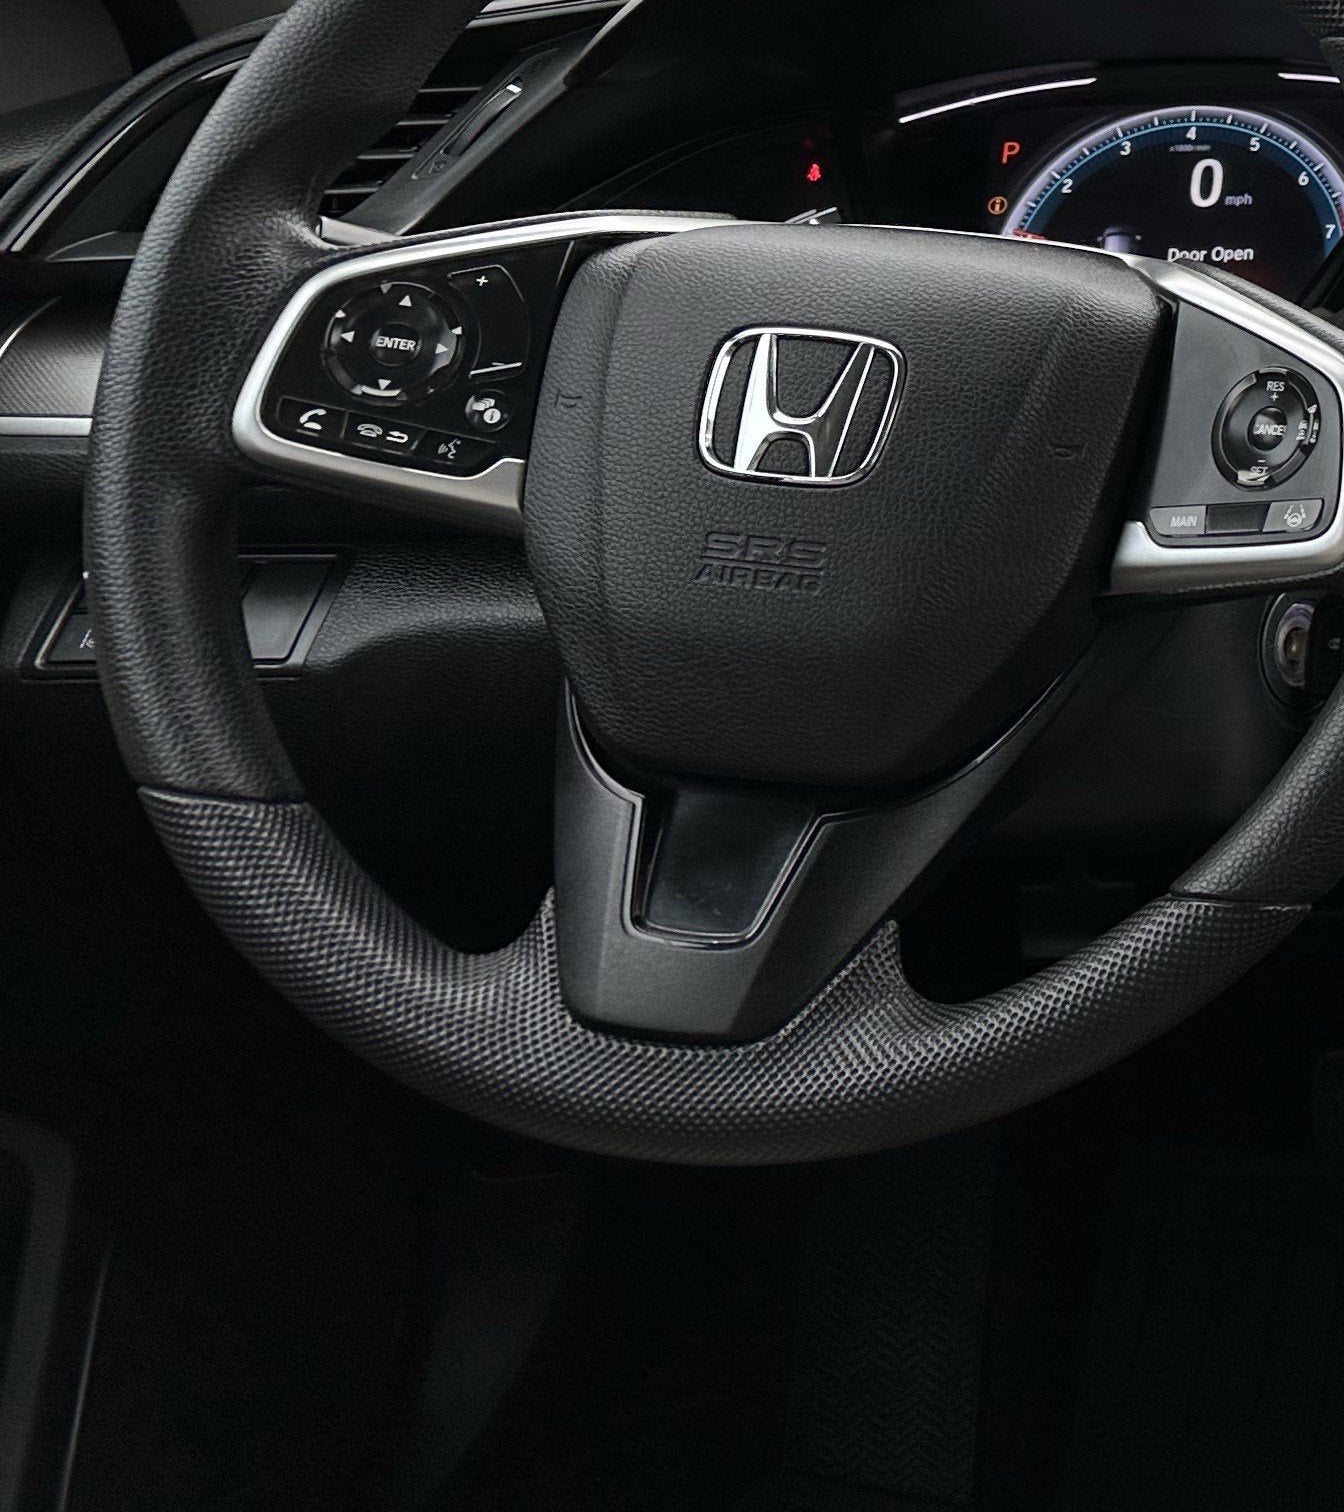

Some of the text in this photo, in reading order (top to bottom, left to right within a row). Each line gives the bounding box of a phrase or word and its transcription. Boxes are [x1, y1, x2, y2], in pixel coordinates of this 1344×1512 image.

[1186, 126, 1197, 141] 4
[1001, 141, 1020, 164] P
[1119, 141, 1132, 156] 3
[1249, 138, 1261, 152] 5
[1190, 158, 1253, 208] 0 mph
[1298, 171, 1310, 186] 6
[1061, 179, 1073, 194] 2
[1324, 224, 1336, 240] 7
[1167, 245, 1254, 263] Door Open
[375, 335, 417, 352] ENTER
[1266, 380, 1286, 392] RES
[1169, 515, 1198, 528] MAIN
[700, 531, 827, 569] SRS
[695, 563, 824, 590] AIRBAG
